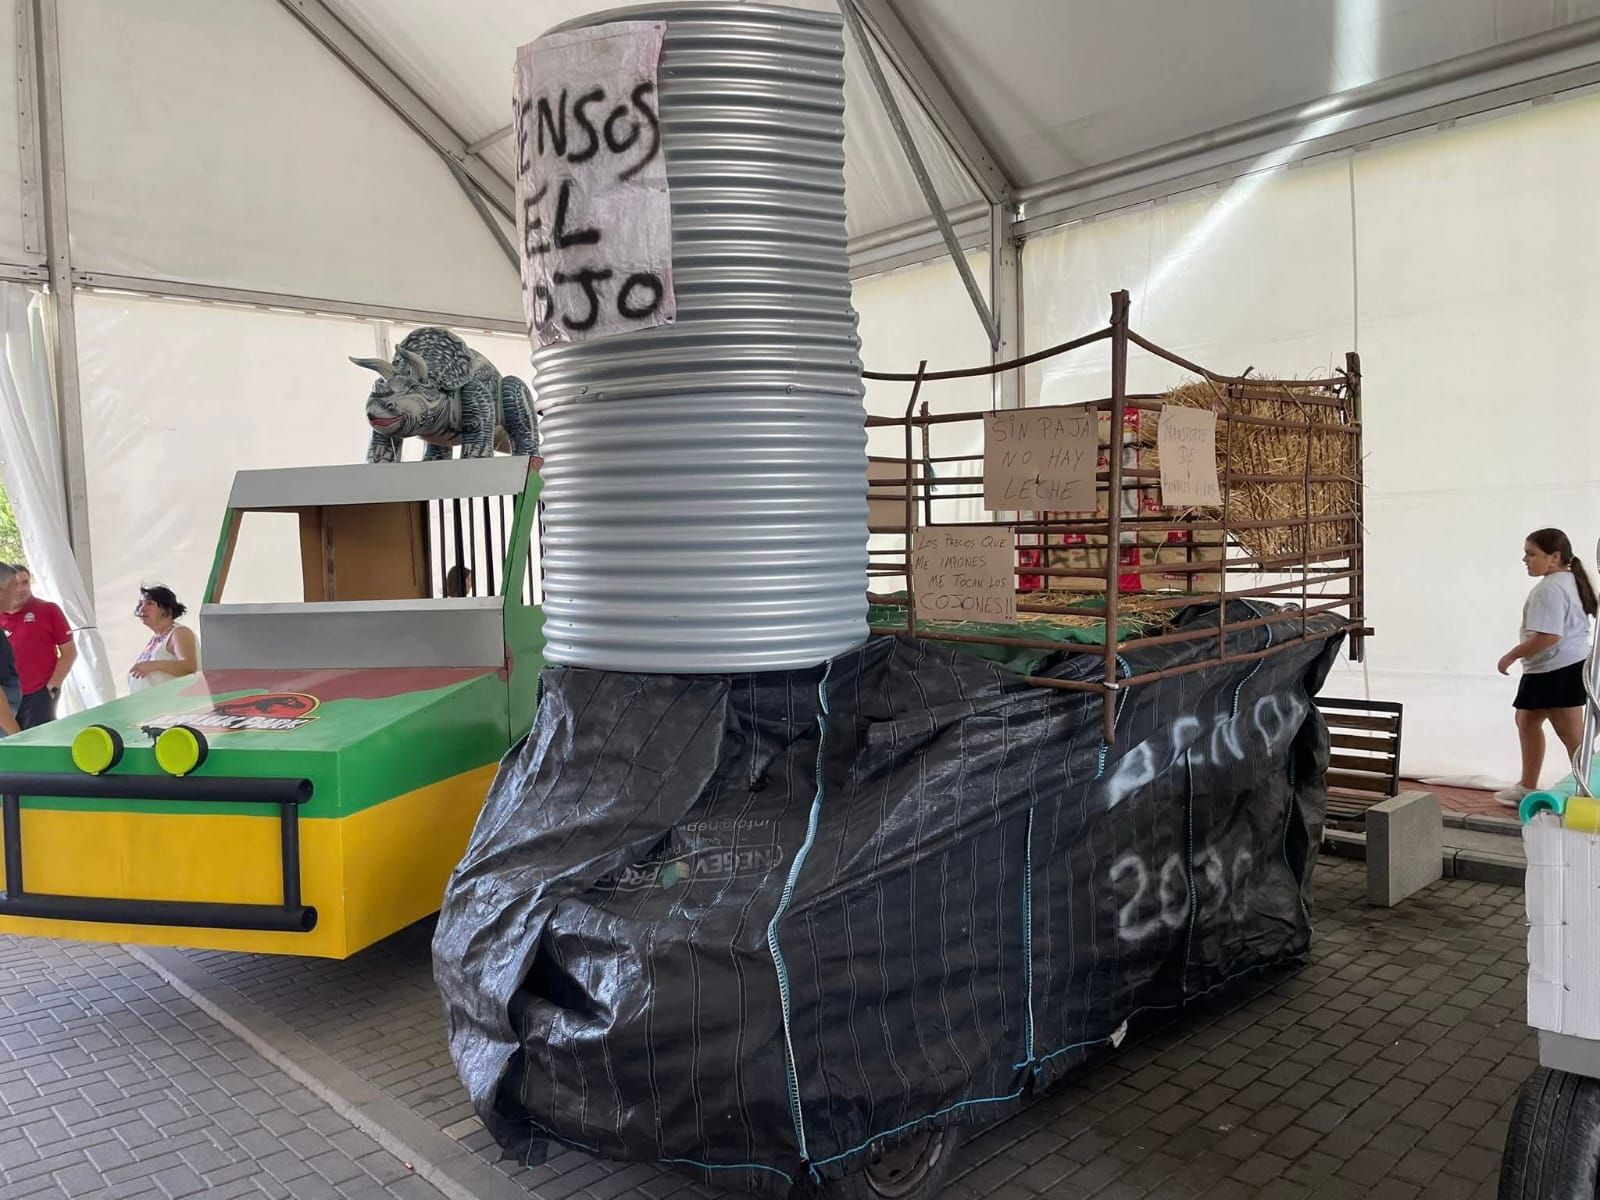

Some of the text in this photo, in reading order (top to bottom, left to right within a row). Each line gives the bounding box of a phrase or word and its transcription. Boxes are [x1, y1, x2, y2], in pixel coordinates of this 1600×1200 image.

[1037, 416, 1090, 439] PAJA
[1001, 447, 1085, 472] NO HAY
[1179, 445, 1195, 465] DE
[1003, 476, 1083, 501] LECHE
[940, 556, 986, 569] IMPONES
[698, 849, 772, 874] NEGEV
